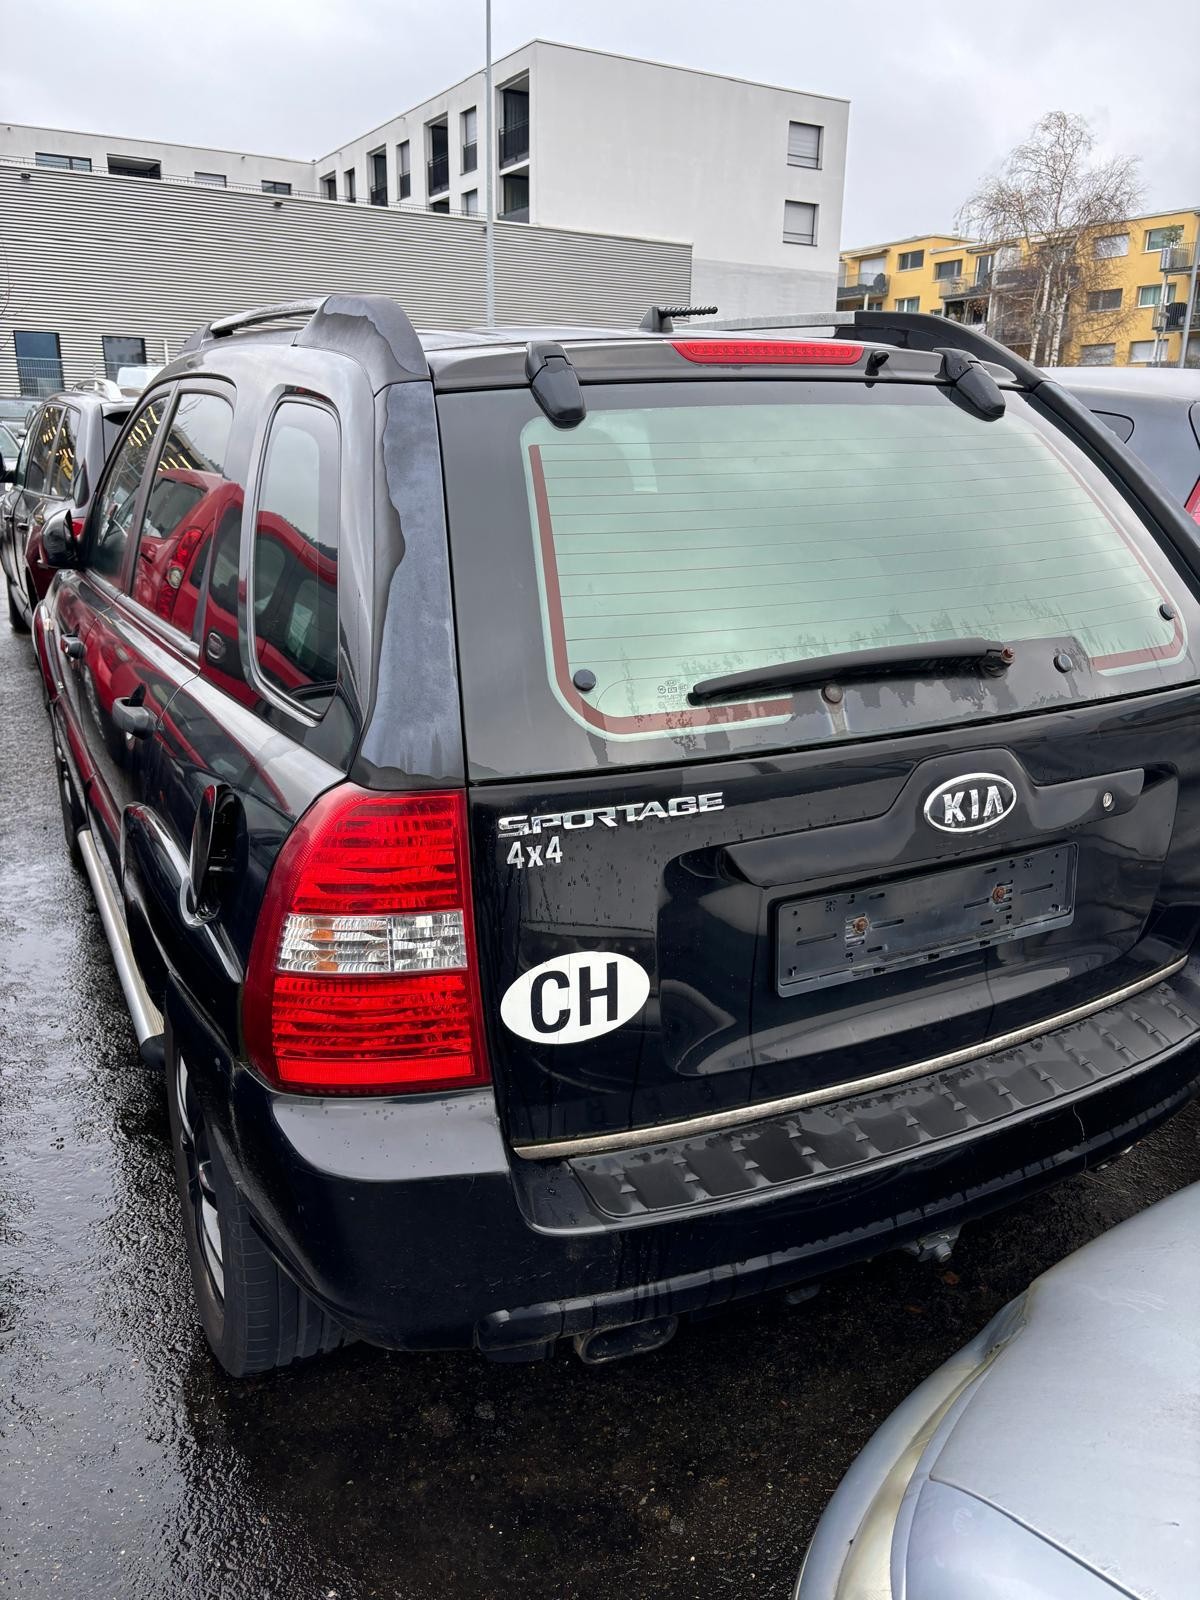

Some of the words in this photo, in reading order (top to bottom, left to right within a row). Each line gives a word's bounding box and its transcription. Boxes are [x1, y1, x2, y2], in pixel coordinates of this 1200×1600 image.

[498, 792, 725, 838] SPORTAGE
[942, 785, 1004, 824] KIA
[506, 836, 563, 869] 4x4
[530, 961, 618, 1034] CH
